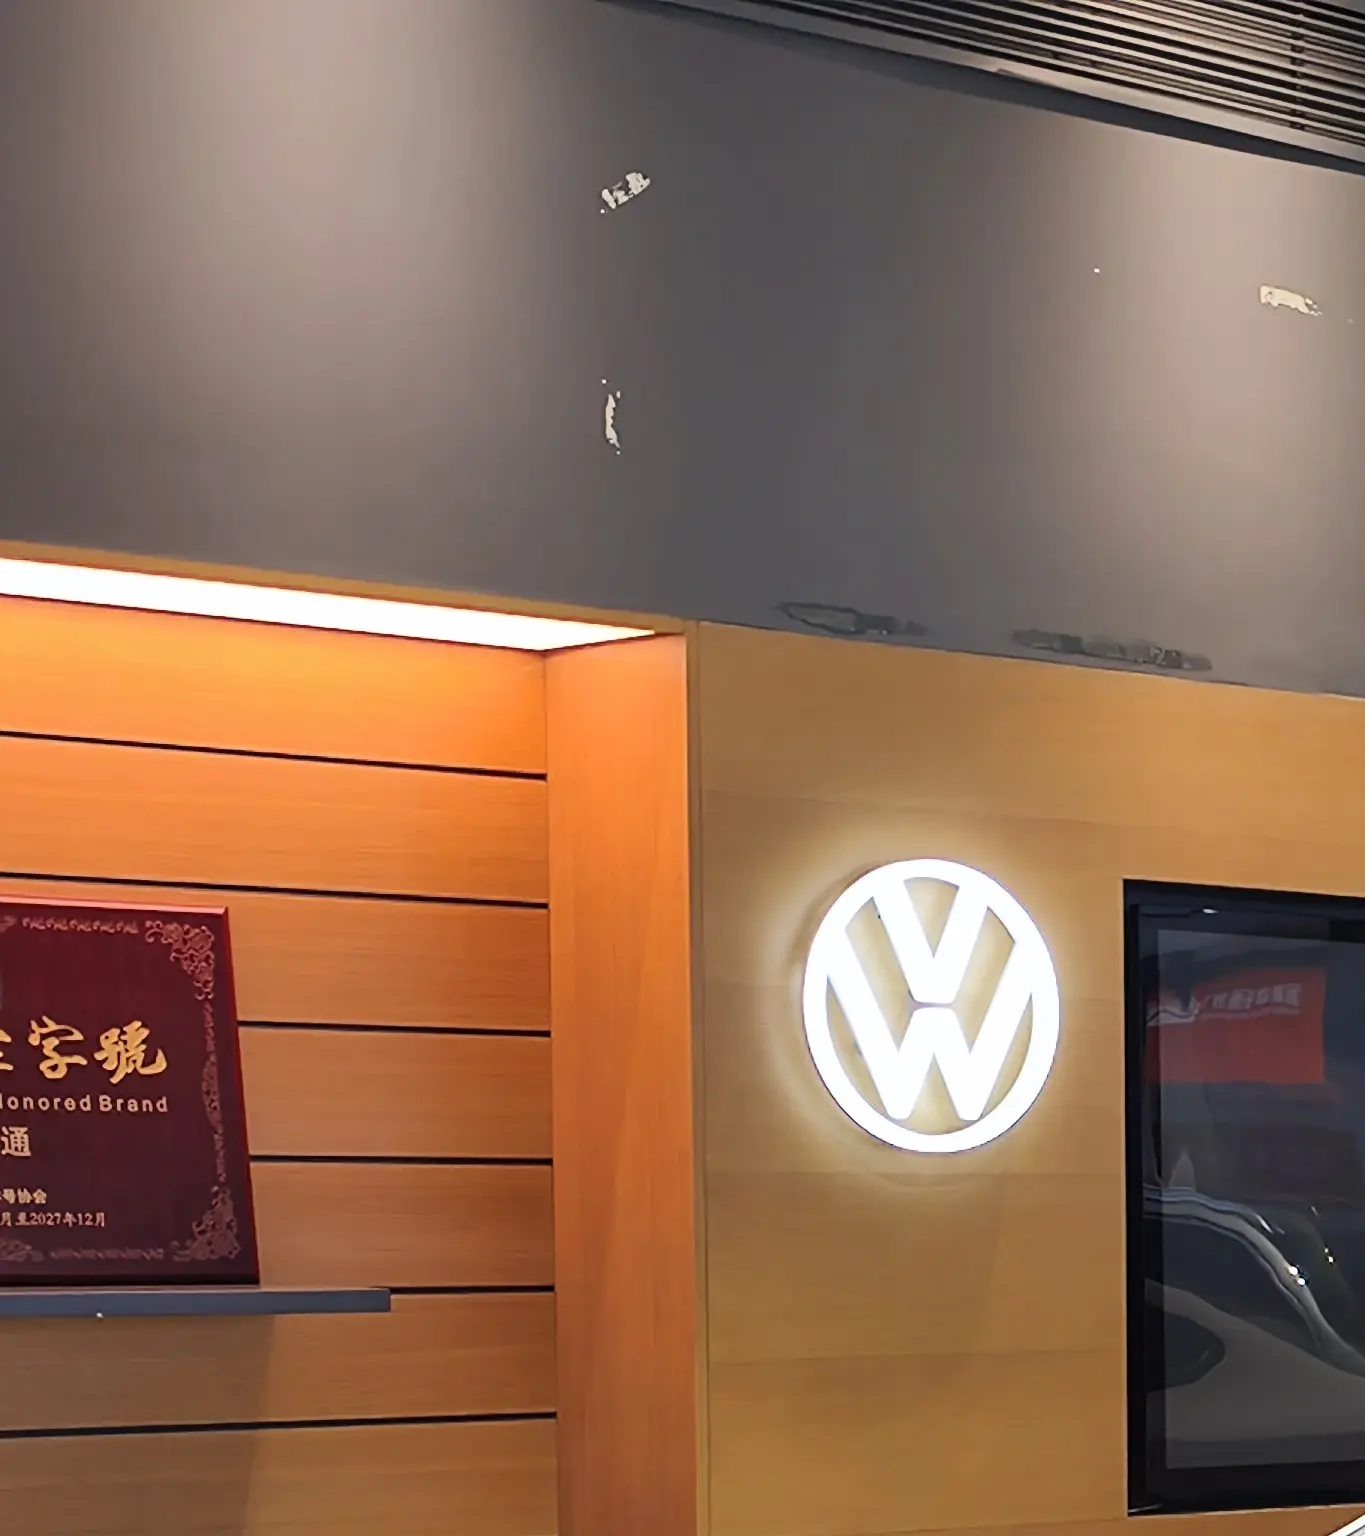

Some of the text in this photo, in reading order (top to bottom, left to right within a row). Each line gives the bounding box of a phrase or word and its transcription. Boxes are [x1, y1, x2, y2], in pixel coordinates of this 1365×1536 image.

[99, 1094, 169, 1114] Brand
[0, 1125, 32, 1157] 通
[0, 1187, 48, 1205] 号协会
